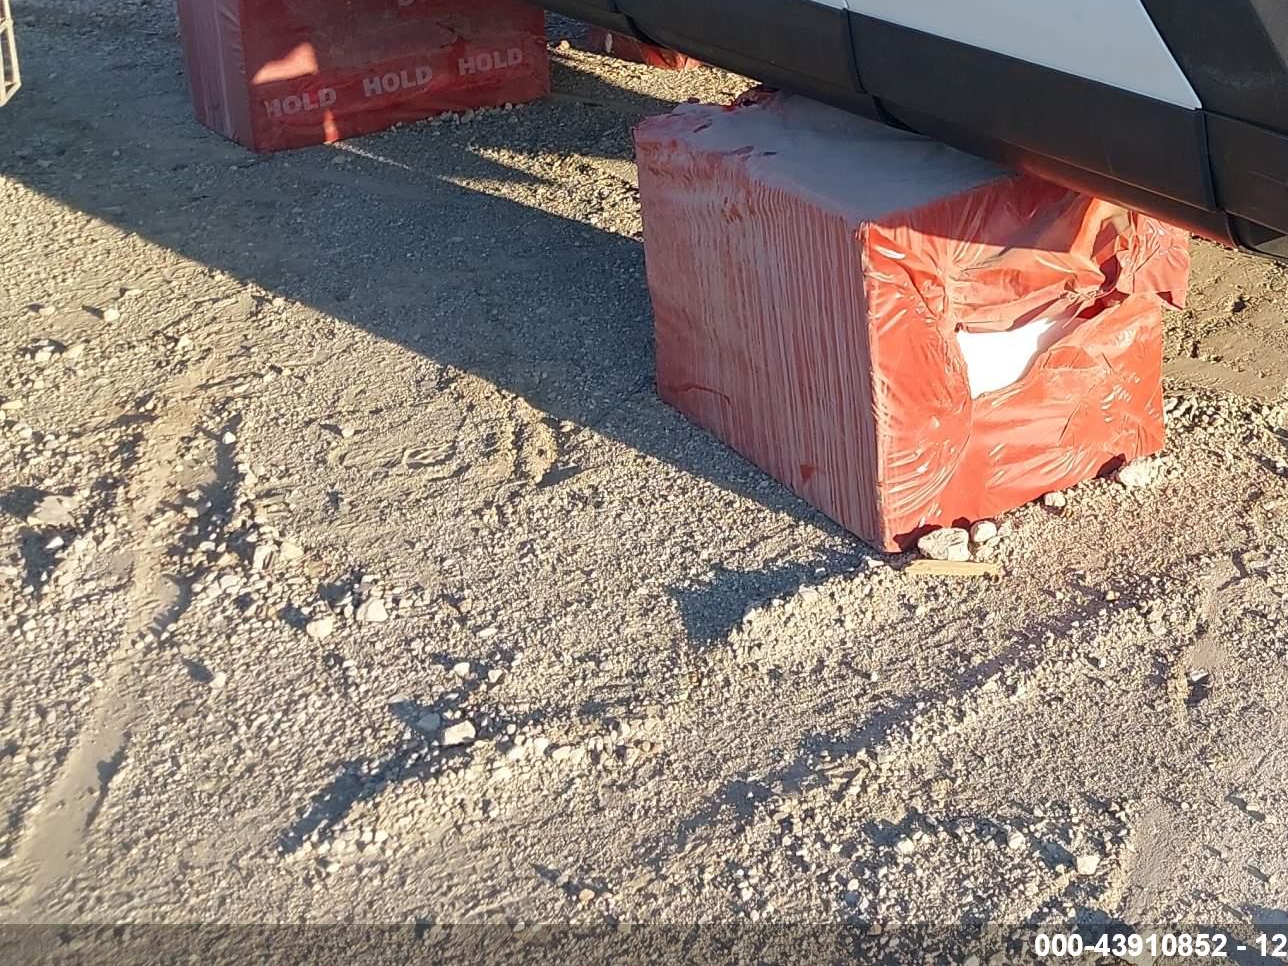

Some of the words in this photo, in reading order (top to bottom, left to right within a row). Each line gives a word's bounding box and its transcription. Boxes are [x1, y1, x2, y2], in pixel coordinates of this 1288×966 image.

[264, 88, 337, 119] HOLD
[362, 65, 433, 97] HOLD
[458, 48, 523, 76] HOLD
